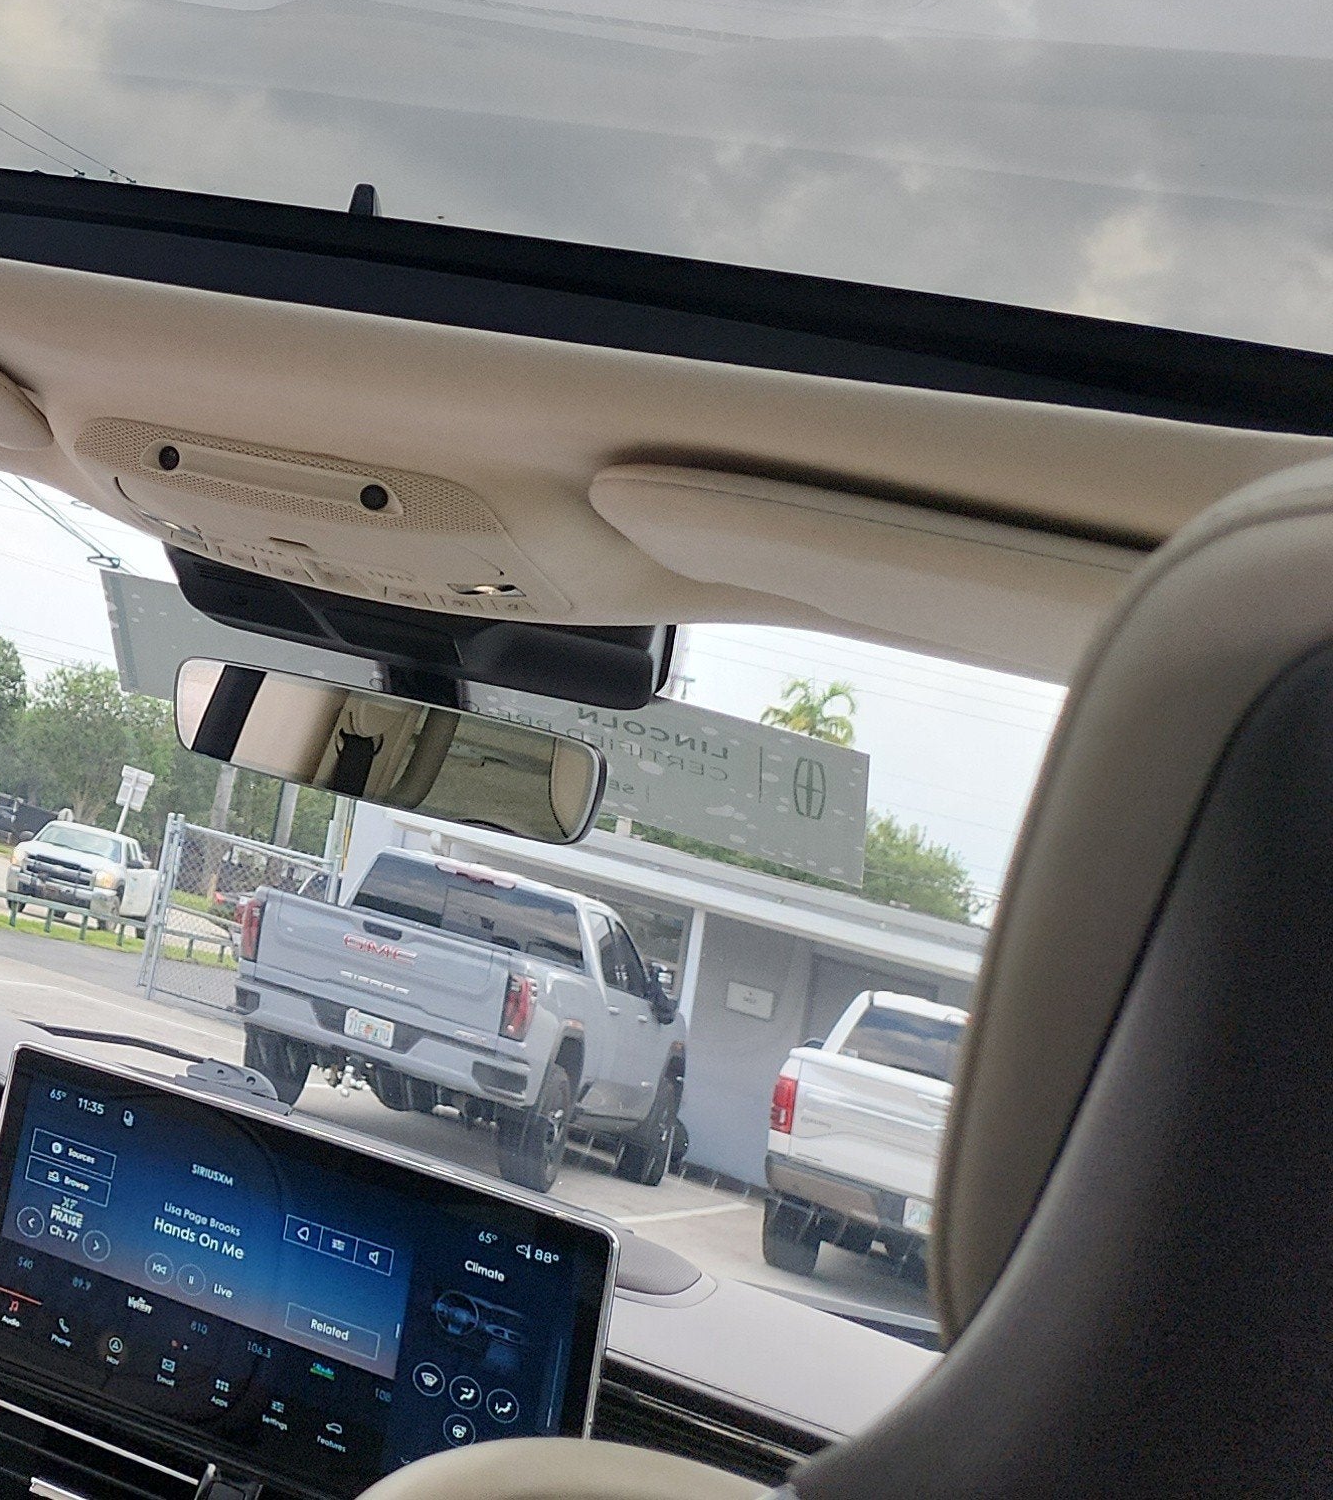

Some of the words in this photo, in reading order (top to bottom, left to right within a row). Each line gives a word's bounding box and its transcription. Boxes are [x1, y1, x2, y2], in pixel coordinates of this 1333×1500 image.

[343, 933, 418, 966] GMC
[78, 1097, 105, 1115] 11:35
[67, 1147, 96, 1165] Sources
[63, 1175, 90, 1192] Browse
[191, 1163, 233, 1187] SIRIUSXM
[50, 1208, 83, 1229] PRAISE
[164, 1201, 182, 1217] Lisa
[183, 1208, 208, 1225] Page
[209, 1217, 241, 1237] Brooks
[49, 1224, 65, 1238] Ch.
[66, 1230, 78, 1242] 77
[154, 1216, 196, 1242] Hands
[199, 1233, 219, 1252] On
[221, 1241, 245, 1260] Me
[534, 1248, 560, 1264] 88°
[464, 1259, 506, 1282] Climate
[213, 1283, 233, 1298] Live
[0, 1314, 21, 1328] Audio
[310, 1318, 350, 1342] Related
[50, 1333, 72, 1348] Phone
[105, 1354, 120, 1366] Nav
[156, 1373, 176, 1387] Email
[210, 1394, 228, 1408] Apps
[261, 1414, 287, 1431] Settings
[316, 1435, 347, 1453] Features
